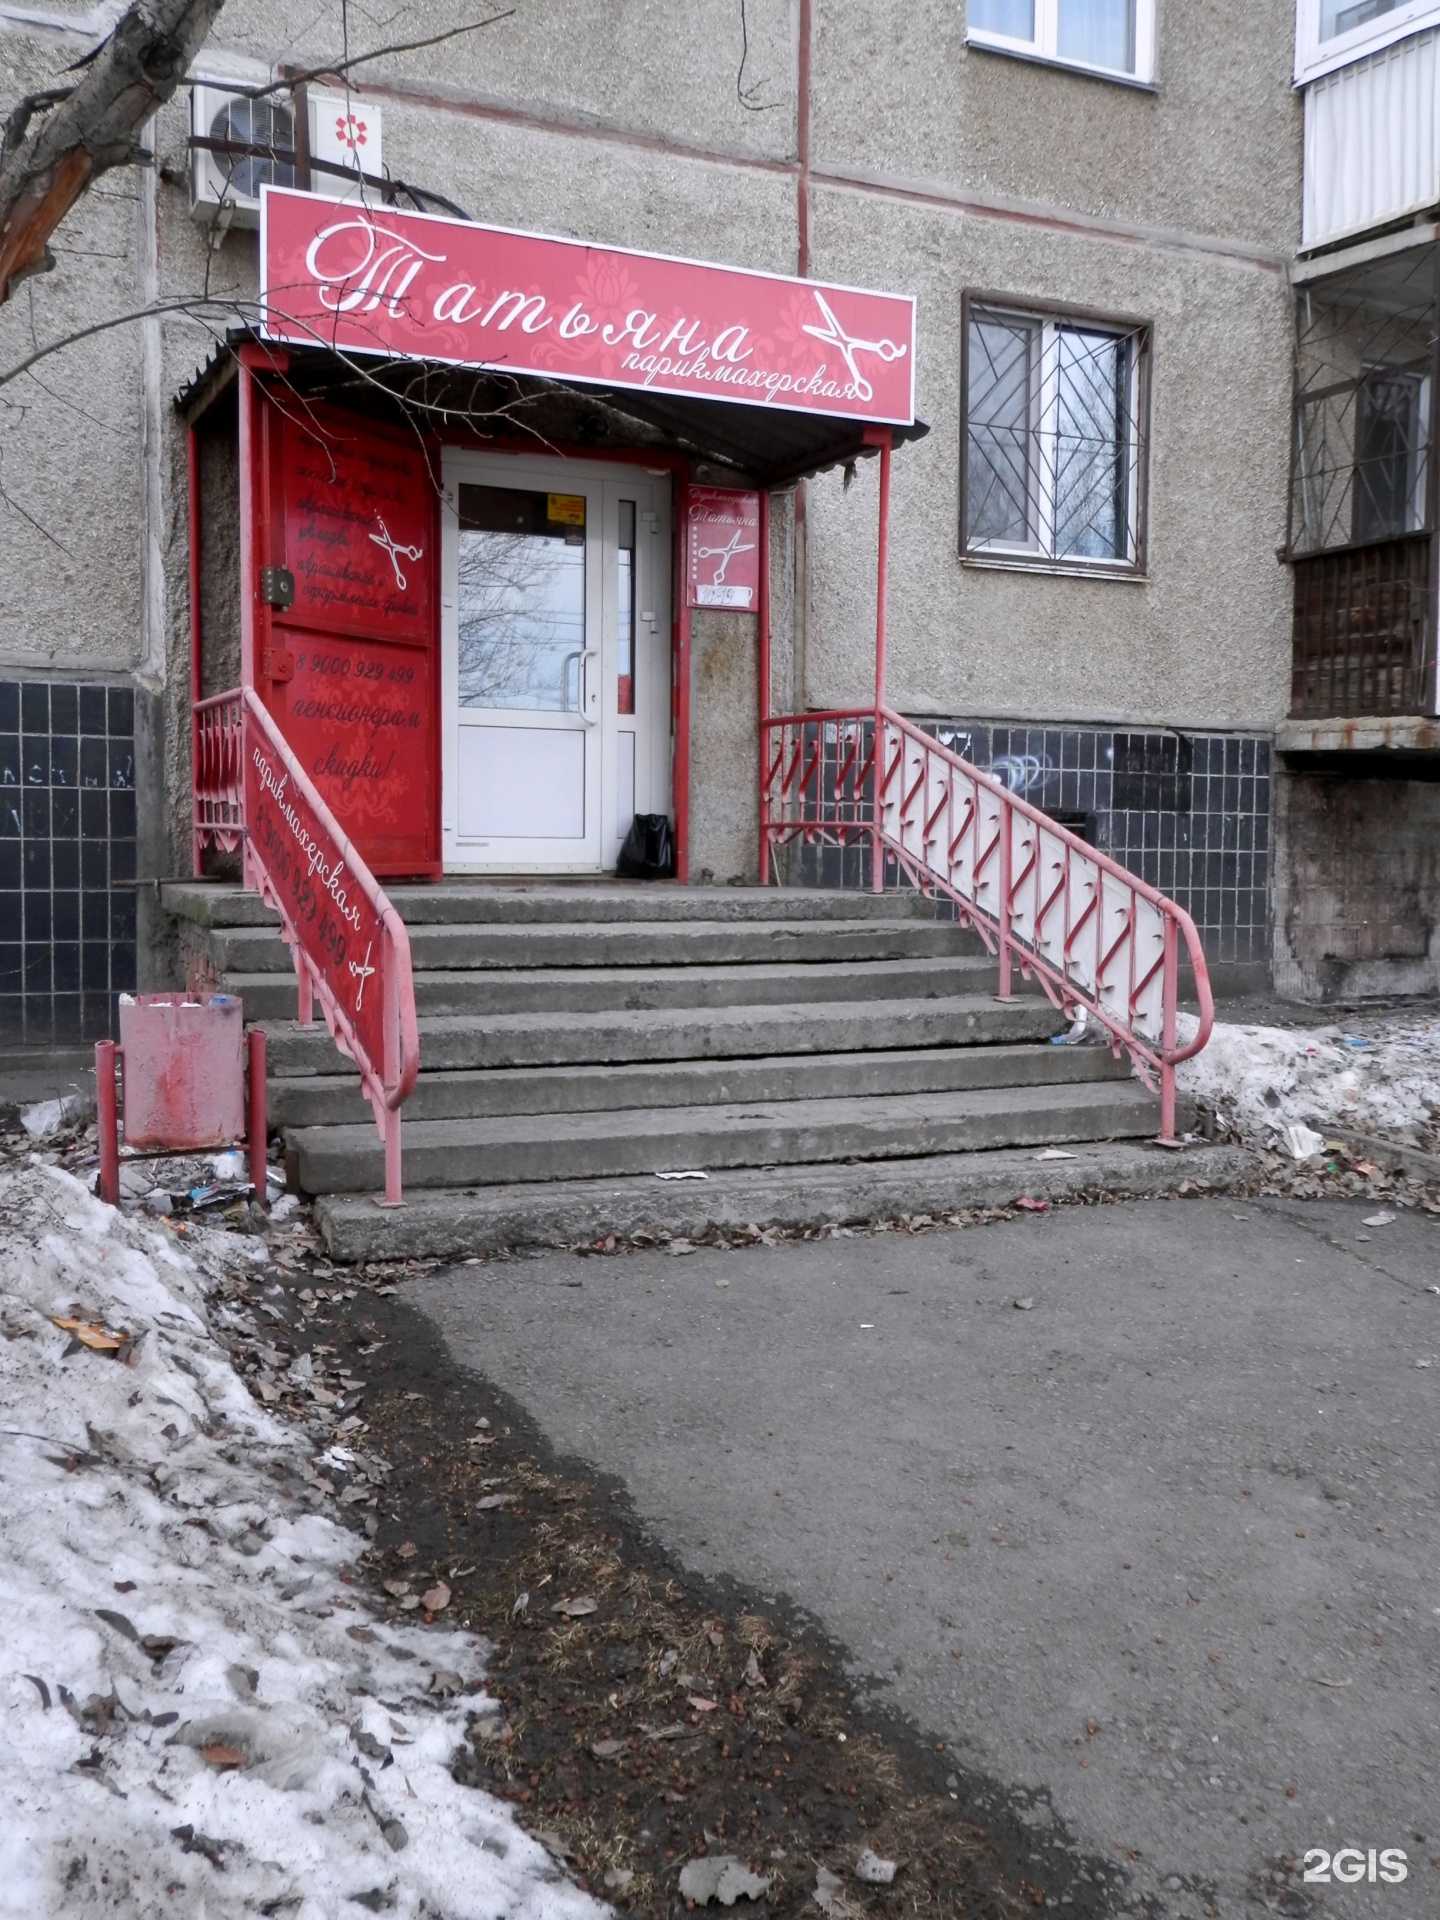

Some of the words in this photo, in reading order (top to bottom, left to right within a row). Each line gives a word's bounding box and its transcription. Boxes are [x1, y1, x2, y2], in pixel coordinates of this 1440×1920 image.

[305, 214, 755, 362] Татьяна
[621, 352, 859, 401] парикмахерская
[252, 747, 361, 931] парикмахерская
